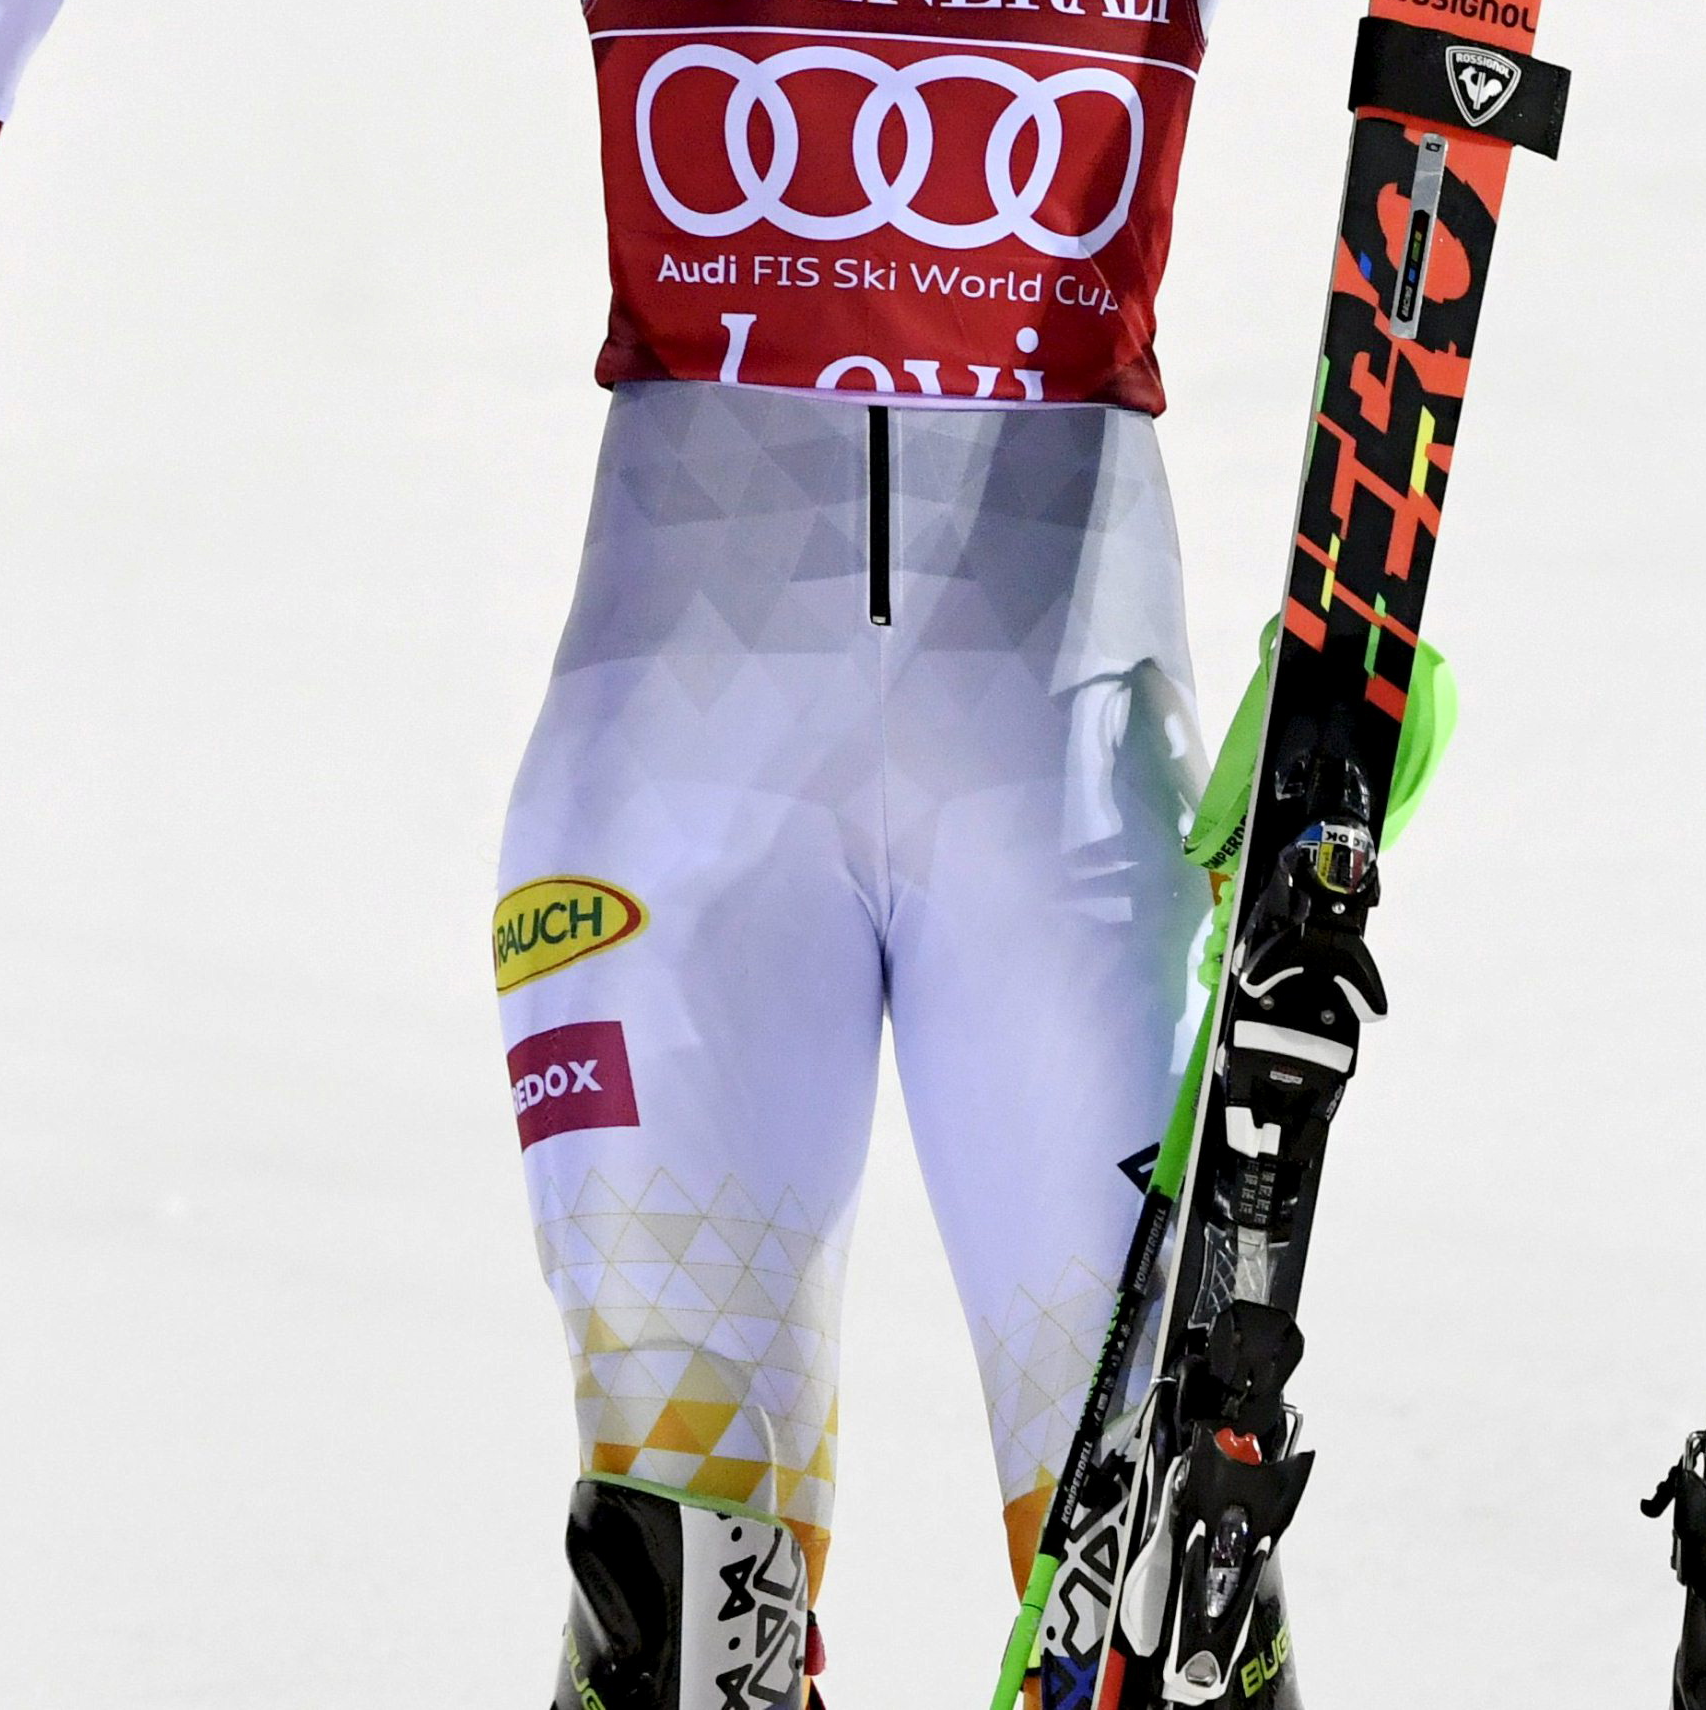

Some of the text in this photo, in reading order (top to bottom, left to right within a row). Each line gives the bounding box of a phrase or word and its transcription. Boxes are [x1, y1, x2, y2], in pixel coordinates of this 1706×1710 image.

[657, 254, 1119, 315] Audi FIS Ski World Cup
[498, 893, 603, 958] RAUCH
[1061, 1440, 1093, 1525] KOMPERDELL
